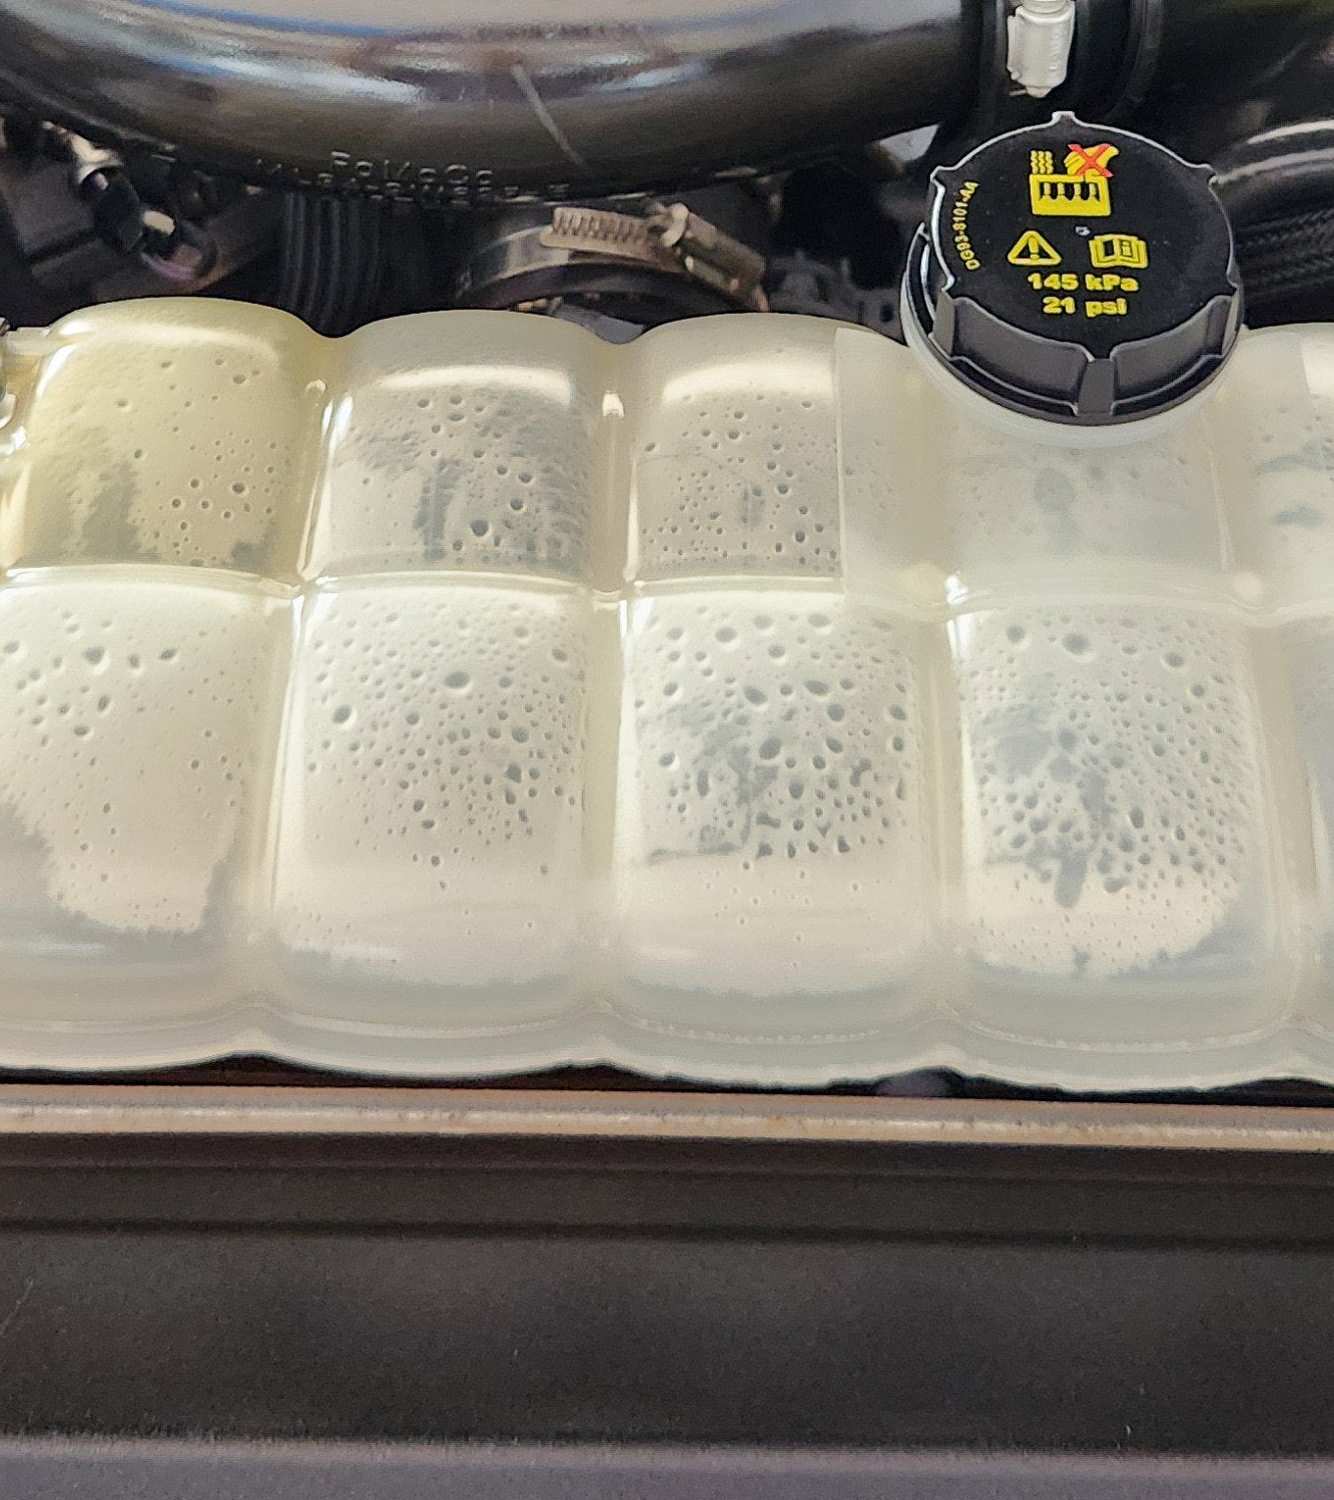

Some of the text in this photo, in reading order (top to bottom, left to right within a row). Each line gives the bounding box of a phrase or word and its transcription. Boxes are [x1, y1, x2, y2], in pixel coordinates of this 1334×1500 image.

[952, 180, 981, 271] DG93-8101-AA
[1027, 272, 1140, 292] 145 kPa
[1042, 296, 1128, 317] 21 psi
